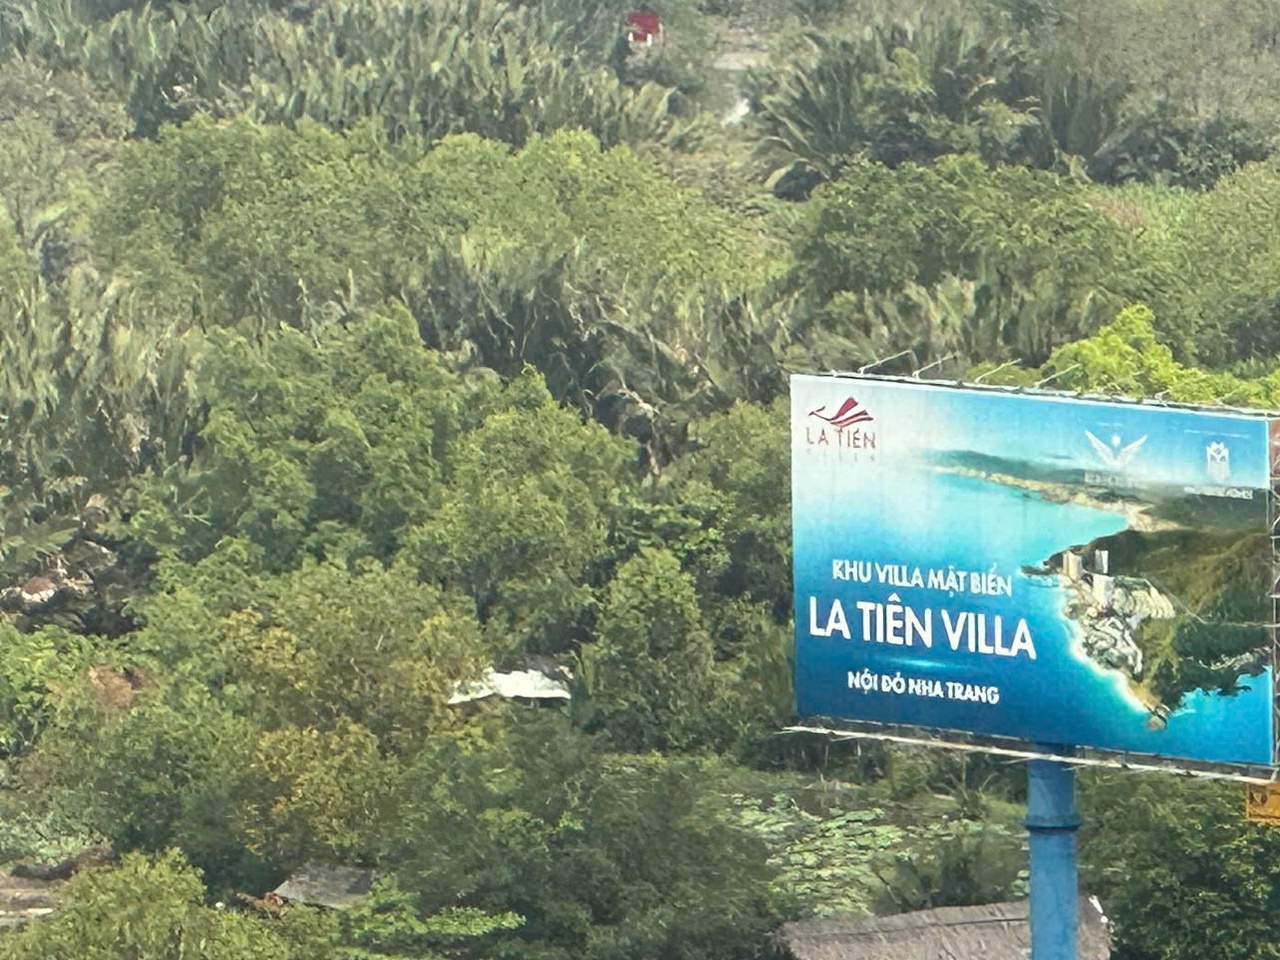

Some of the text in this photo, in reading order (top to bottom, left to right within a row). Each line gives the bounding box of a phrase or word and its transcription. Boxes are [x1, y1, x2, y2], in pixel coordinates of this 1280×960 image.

[806, 426, 829, 446] LA
[832, 559, 872, 583] KHU
[875, 562, 924, 589] VILLA
[809, 592, 1037, 660] LA TIÊN VILLA
[908, 678, 944, 698] NHA
[946, 681, 1000, 705] TRANG
